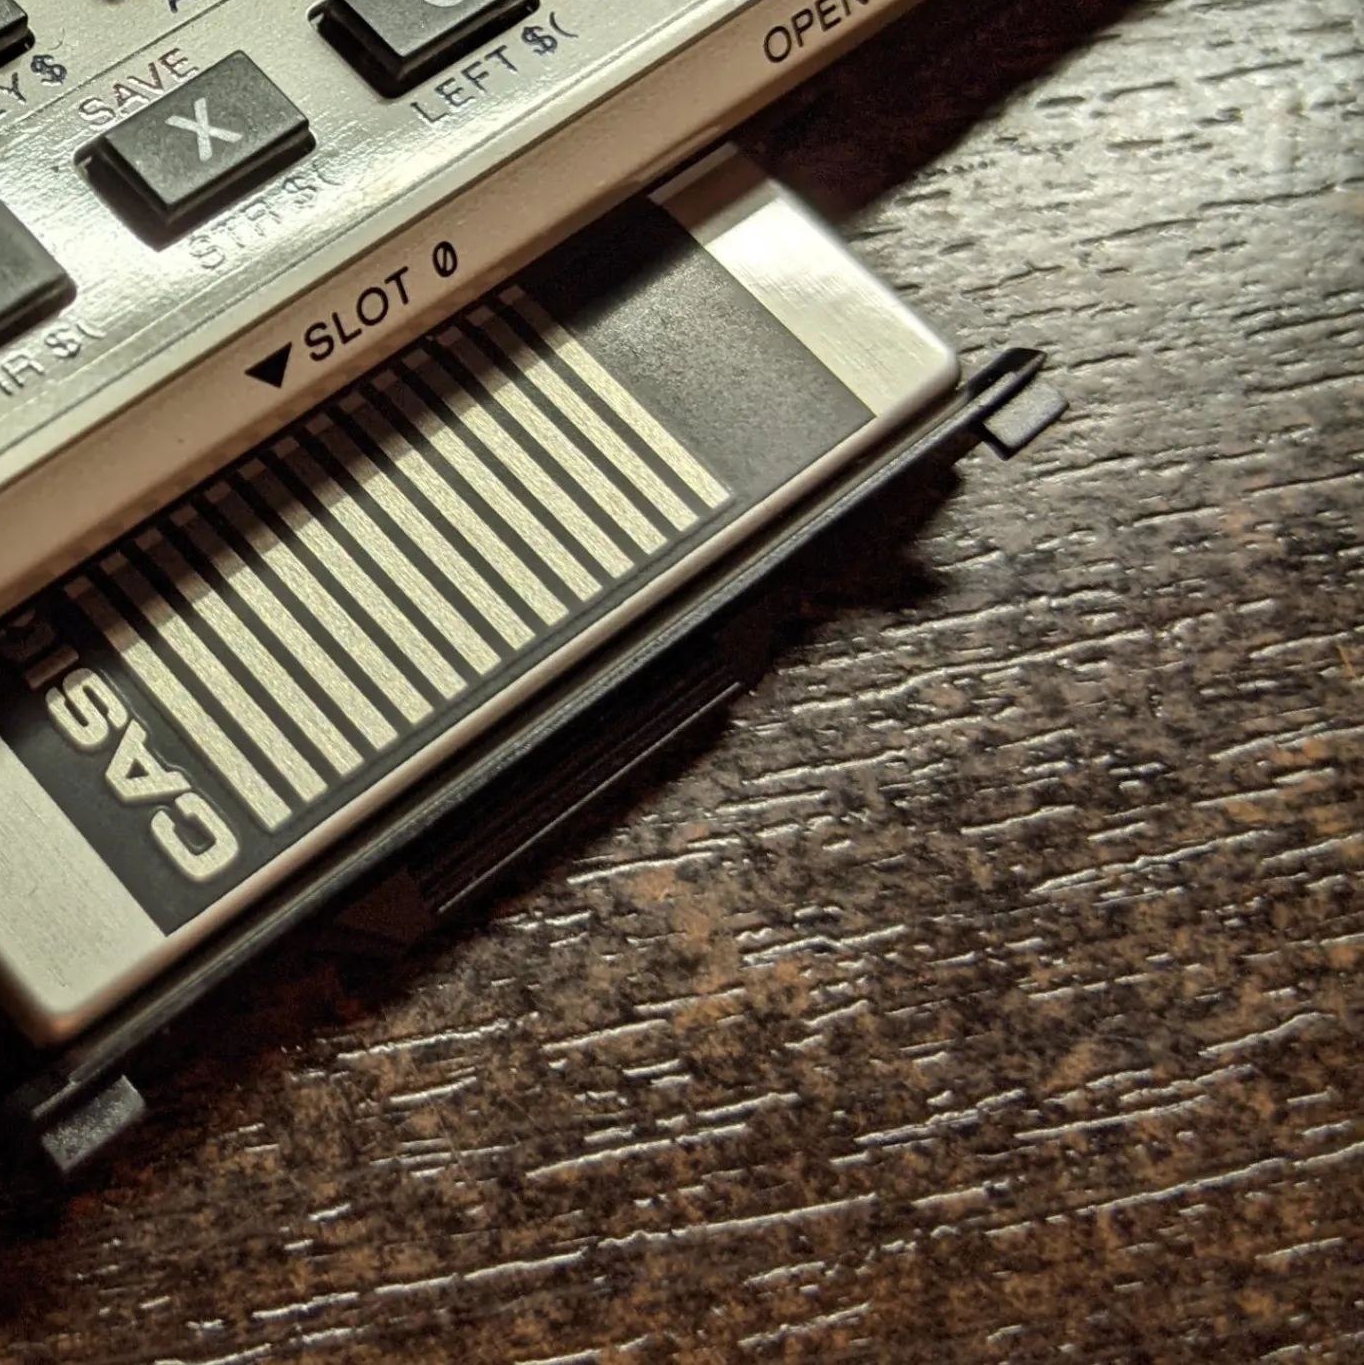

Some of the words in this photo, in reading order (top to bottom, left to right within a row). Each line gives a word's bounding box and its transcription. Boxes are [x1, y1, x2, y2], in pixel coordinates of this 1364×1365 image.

[78, 46, 201, 131] SAVE
[166, 99, 242, 159] X
[304, 266, 411, 365] SLOT
